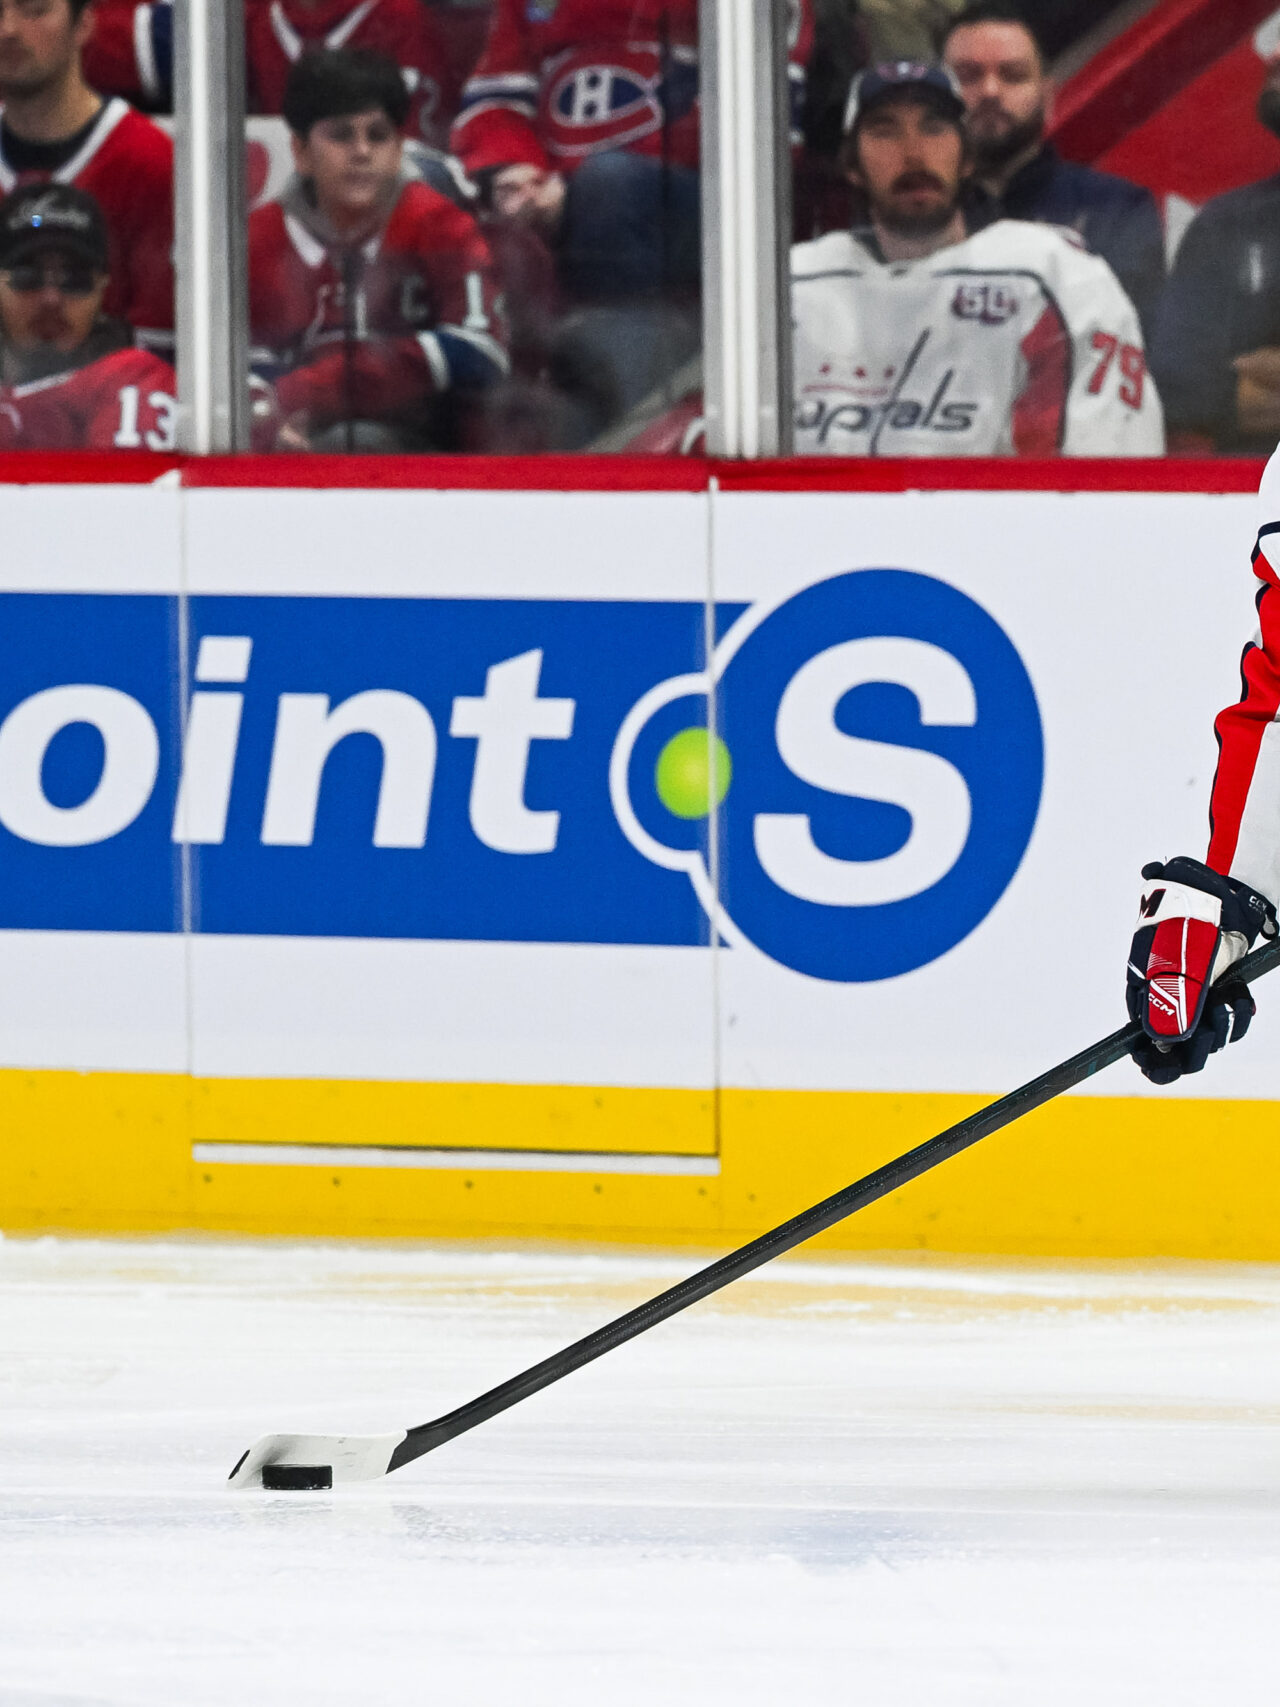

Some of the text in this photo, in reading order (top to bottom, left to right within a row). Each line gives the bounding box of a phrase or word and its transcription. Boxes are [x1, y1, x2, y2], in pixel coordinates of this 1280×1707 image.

[1088, 330, 1147, 411] 79
[114, 386, 179, 451] 13
[753, 636, 978, 907] S
[1148, 993, 1176, 1017] CCM
